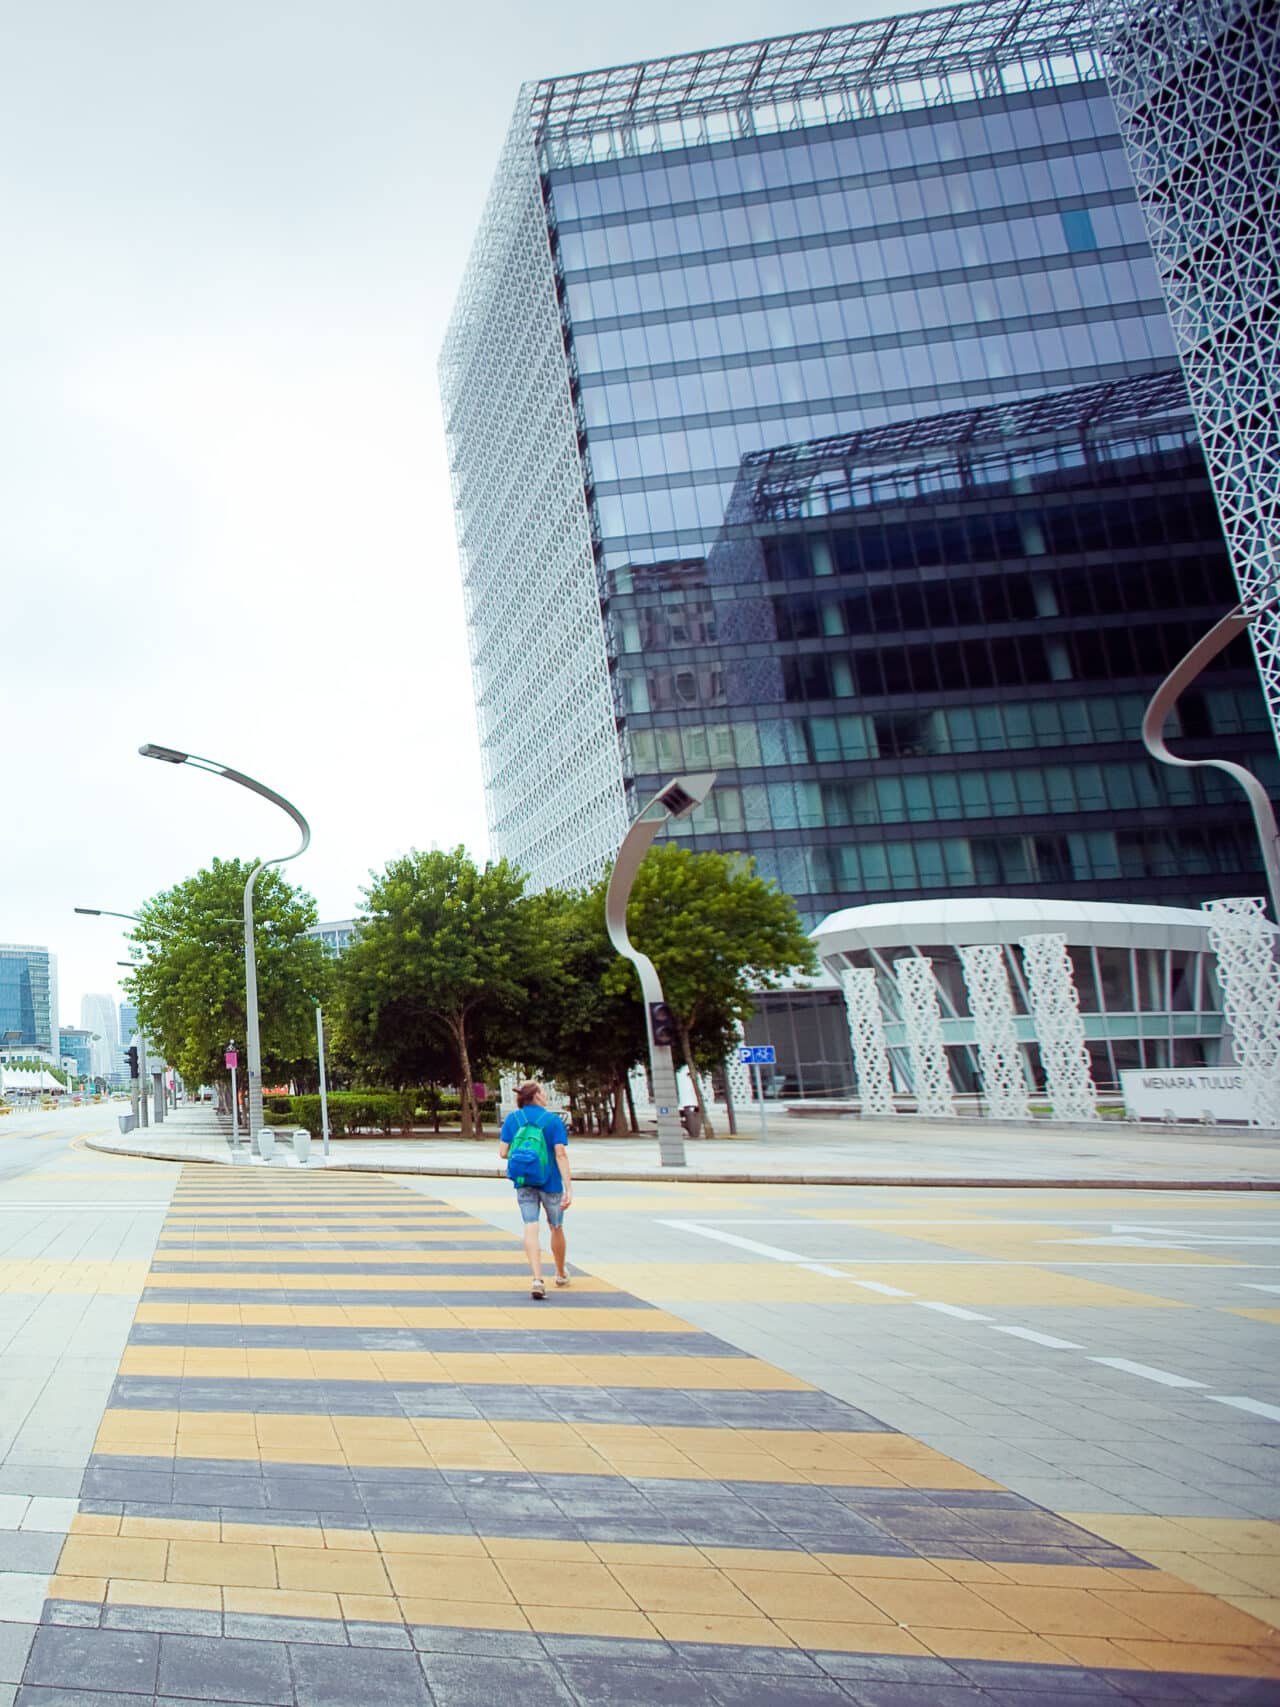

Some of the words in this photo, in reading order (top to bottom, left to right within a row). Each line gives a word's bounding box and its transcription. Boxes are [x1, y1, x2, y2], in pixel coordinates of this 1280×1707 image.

[741, 1049, 752, 1061] P
[1142, 1077, 1197, 1089] MENARA
[1198, 1076, 1242, 1089] TULUS
